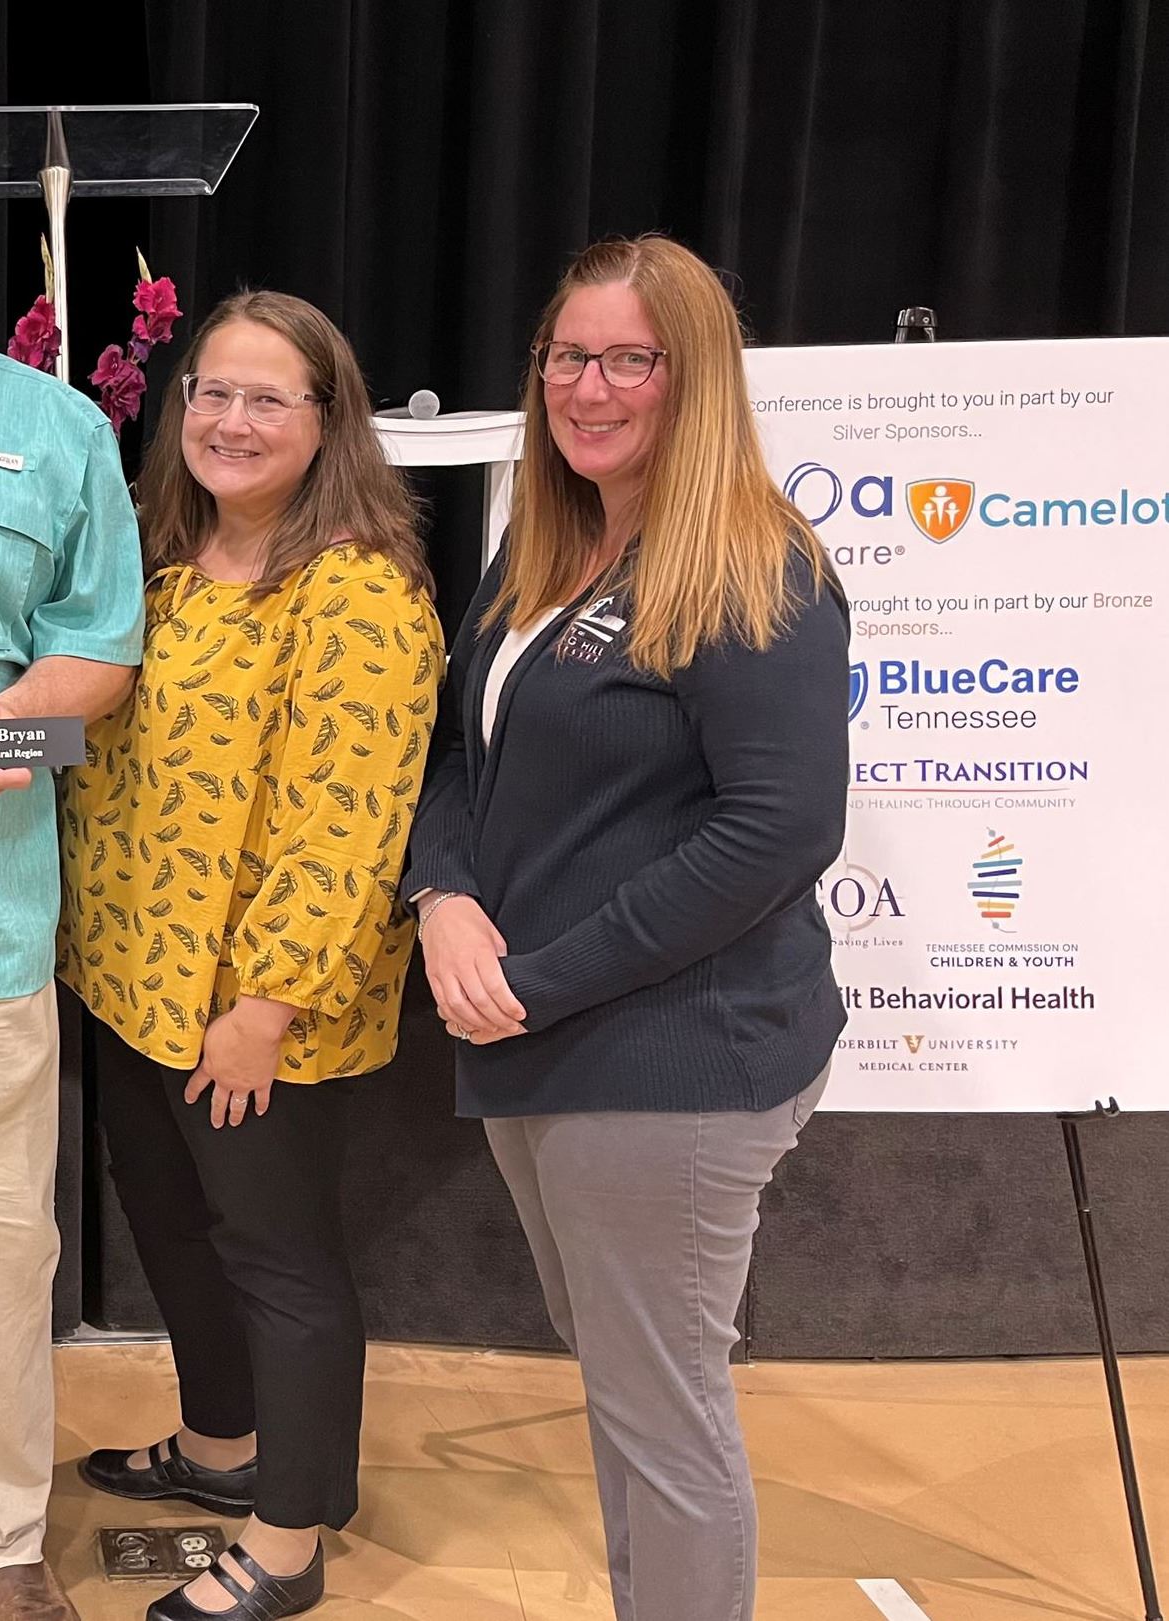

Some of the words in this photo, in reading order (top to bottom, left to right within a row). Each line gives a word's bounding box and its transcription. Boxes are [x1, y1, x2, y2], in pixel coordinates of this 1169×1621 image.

[848, 395, 862, 410] is
[868, 392, 935, 413] brought
[941, 393, 958, 408] to
[963, 393, 994, 411] you
[1000, 391, 1014, 406] in
[1020, 390, 1055, 409] part
[1060, 388, 1080, 408] by
[1085, 391, 1114, 404] our
[833, 423, 880, 440] Silver
[885, 422, 983, 442] Sponsors...
[916, 597, 932, 611] to
[937, 598, 968, 615] you
[974, 595, 988, 610] in
[994, 595, 1029, 613] part
[1034, 593, 1054, 613] by
[1059, 596, 1088, 608] our
[1093, 592, 1153, 608] Bronze
[856, 620, 953, 639] Sponsors...
[581, 641, 604, 657] HILL
[880, 659, 1079, 694] BlueCare
[880, 705, 1037, 729] Tennessee
[14, 748, 43, 760] Region
[914, 760, 1089, 782] TRANSITION
[873, 936, 904, 947] Lives
[926, 943, 985, 953] TENNESSEE
[988, 943, 1059, 953] COMMISSION
[1062, 943, 1079, 952] ON
[930, 956, 1004, 967] CHILDREN
[1008, 956, 1018, 967] &
[1023, 956, 1074, 967] YOUTH
[870, 985, 1003, 1009] Behavioral
[1011, 985, 1095, 1009] Health
[928, 1039, 1019, 1050] UNIVERSITY
[859, 1062, 914, 1071] MEDICAL
[919, 1062, 969, 1071] CENTER
